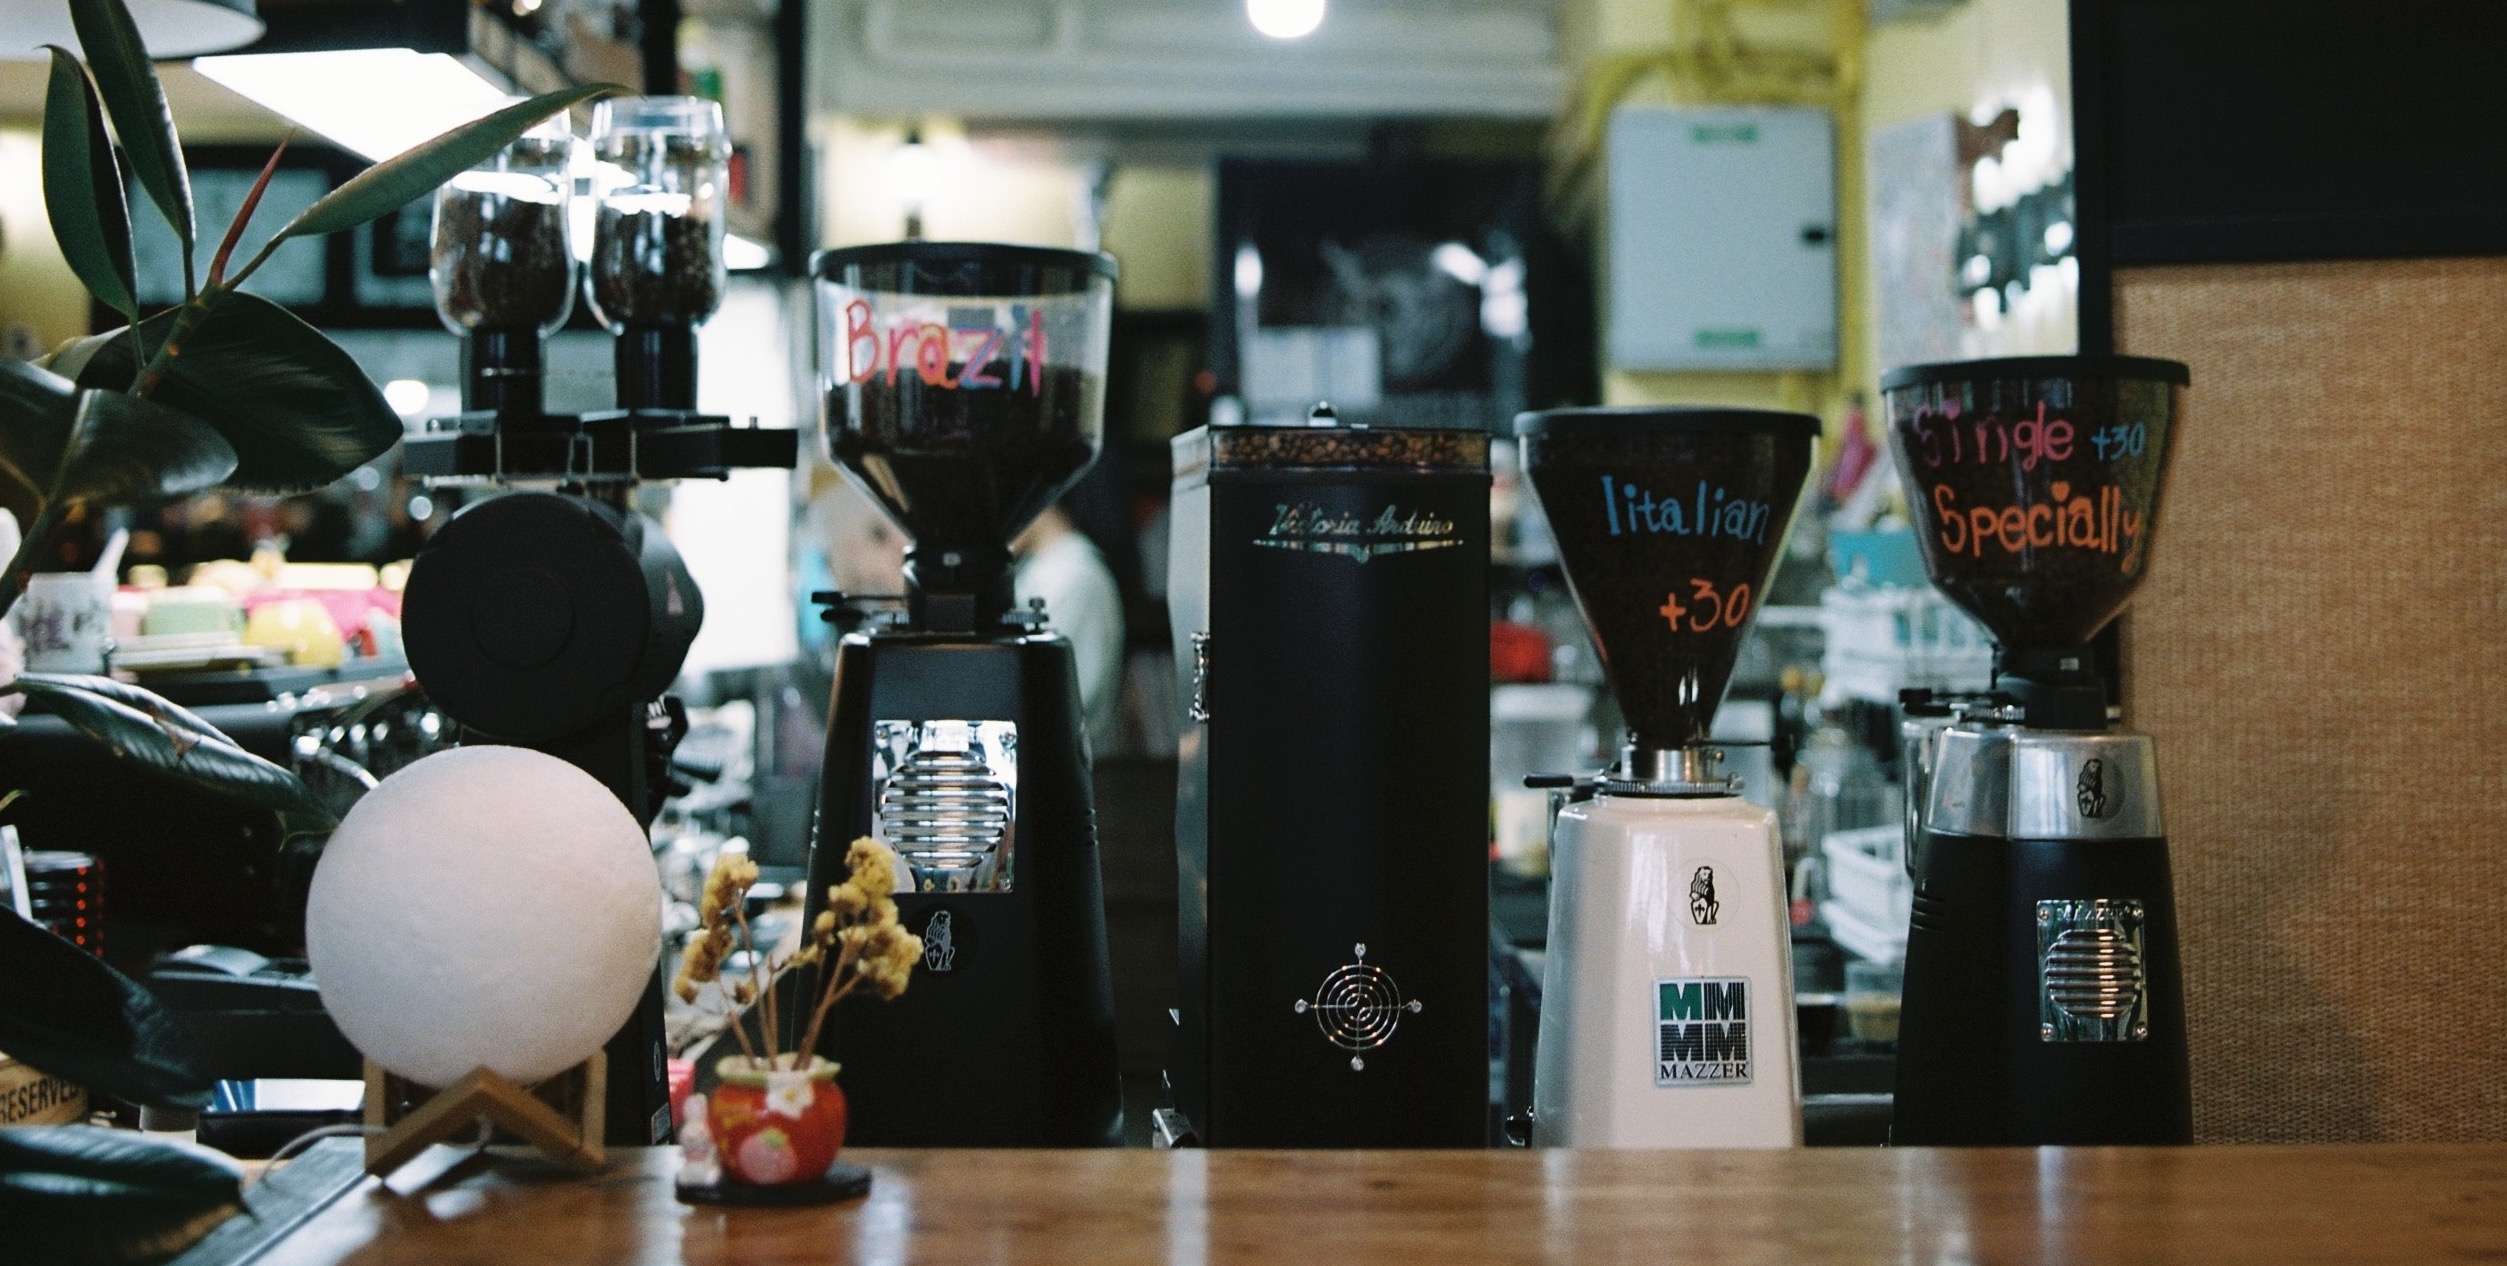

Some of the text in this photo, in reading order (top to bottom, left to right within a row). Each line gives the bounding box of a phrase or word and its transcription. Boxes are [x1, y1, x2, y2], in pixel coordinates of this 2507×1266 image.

[847, 299, 1046, 398] Brazil
[1911, 397, 2145, 471] Single +30
[1934, 481, 2141, 573] Specially
[1660, 578, 1751, 632] +30
[1660, 1062, 1747, 1079] MAZZER
